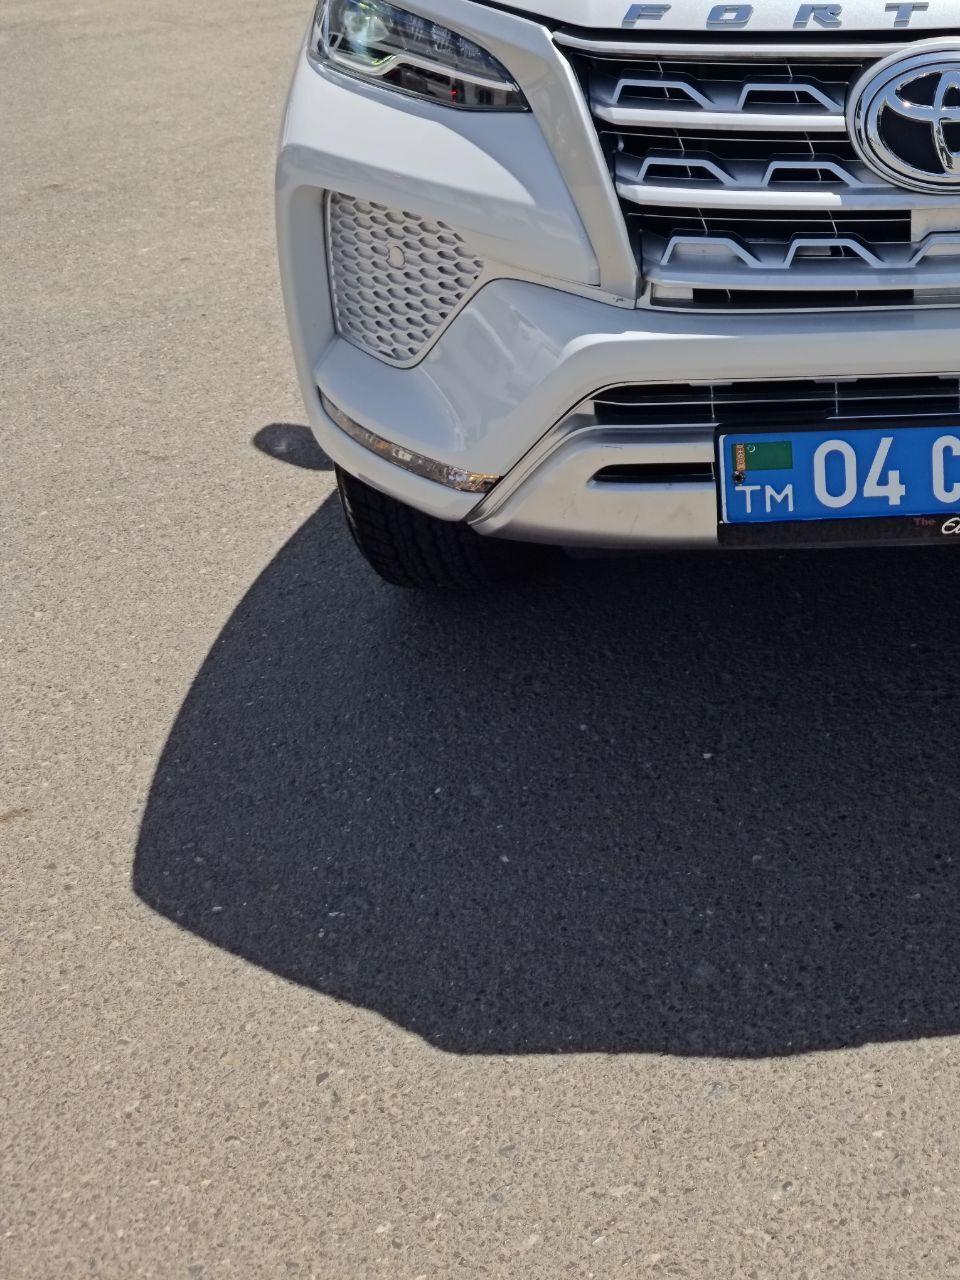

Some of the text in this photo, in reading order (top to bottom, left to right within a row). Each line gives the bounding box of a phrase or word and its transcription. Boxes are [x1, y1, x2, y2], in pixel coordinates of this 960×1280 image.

[813, 437, 906, 508] 04
[735, 483, 794, 513] TM
[914, 518, 936, 527] The
